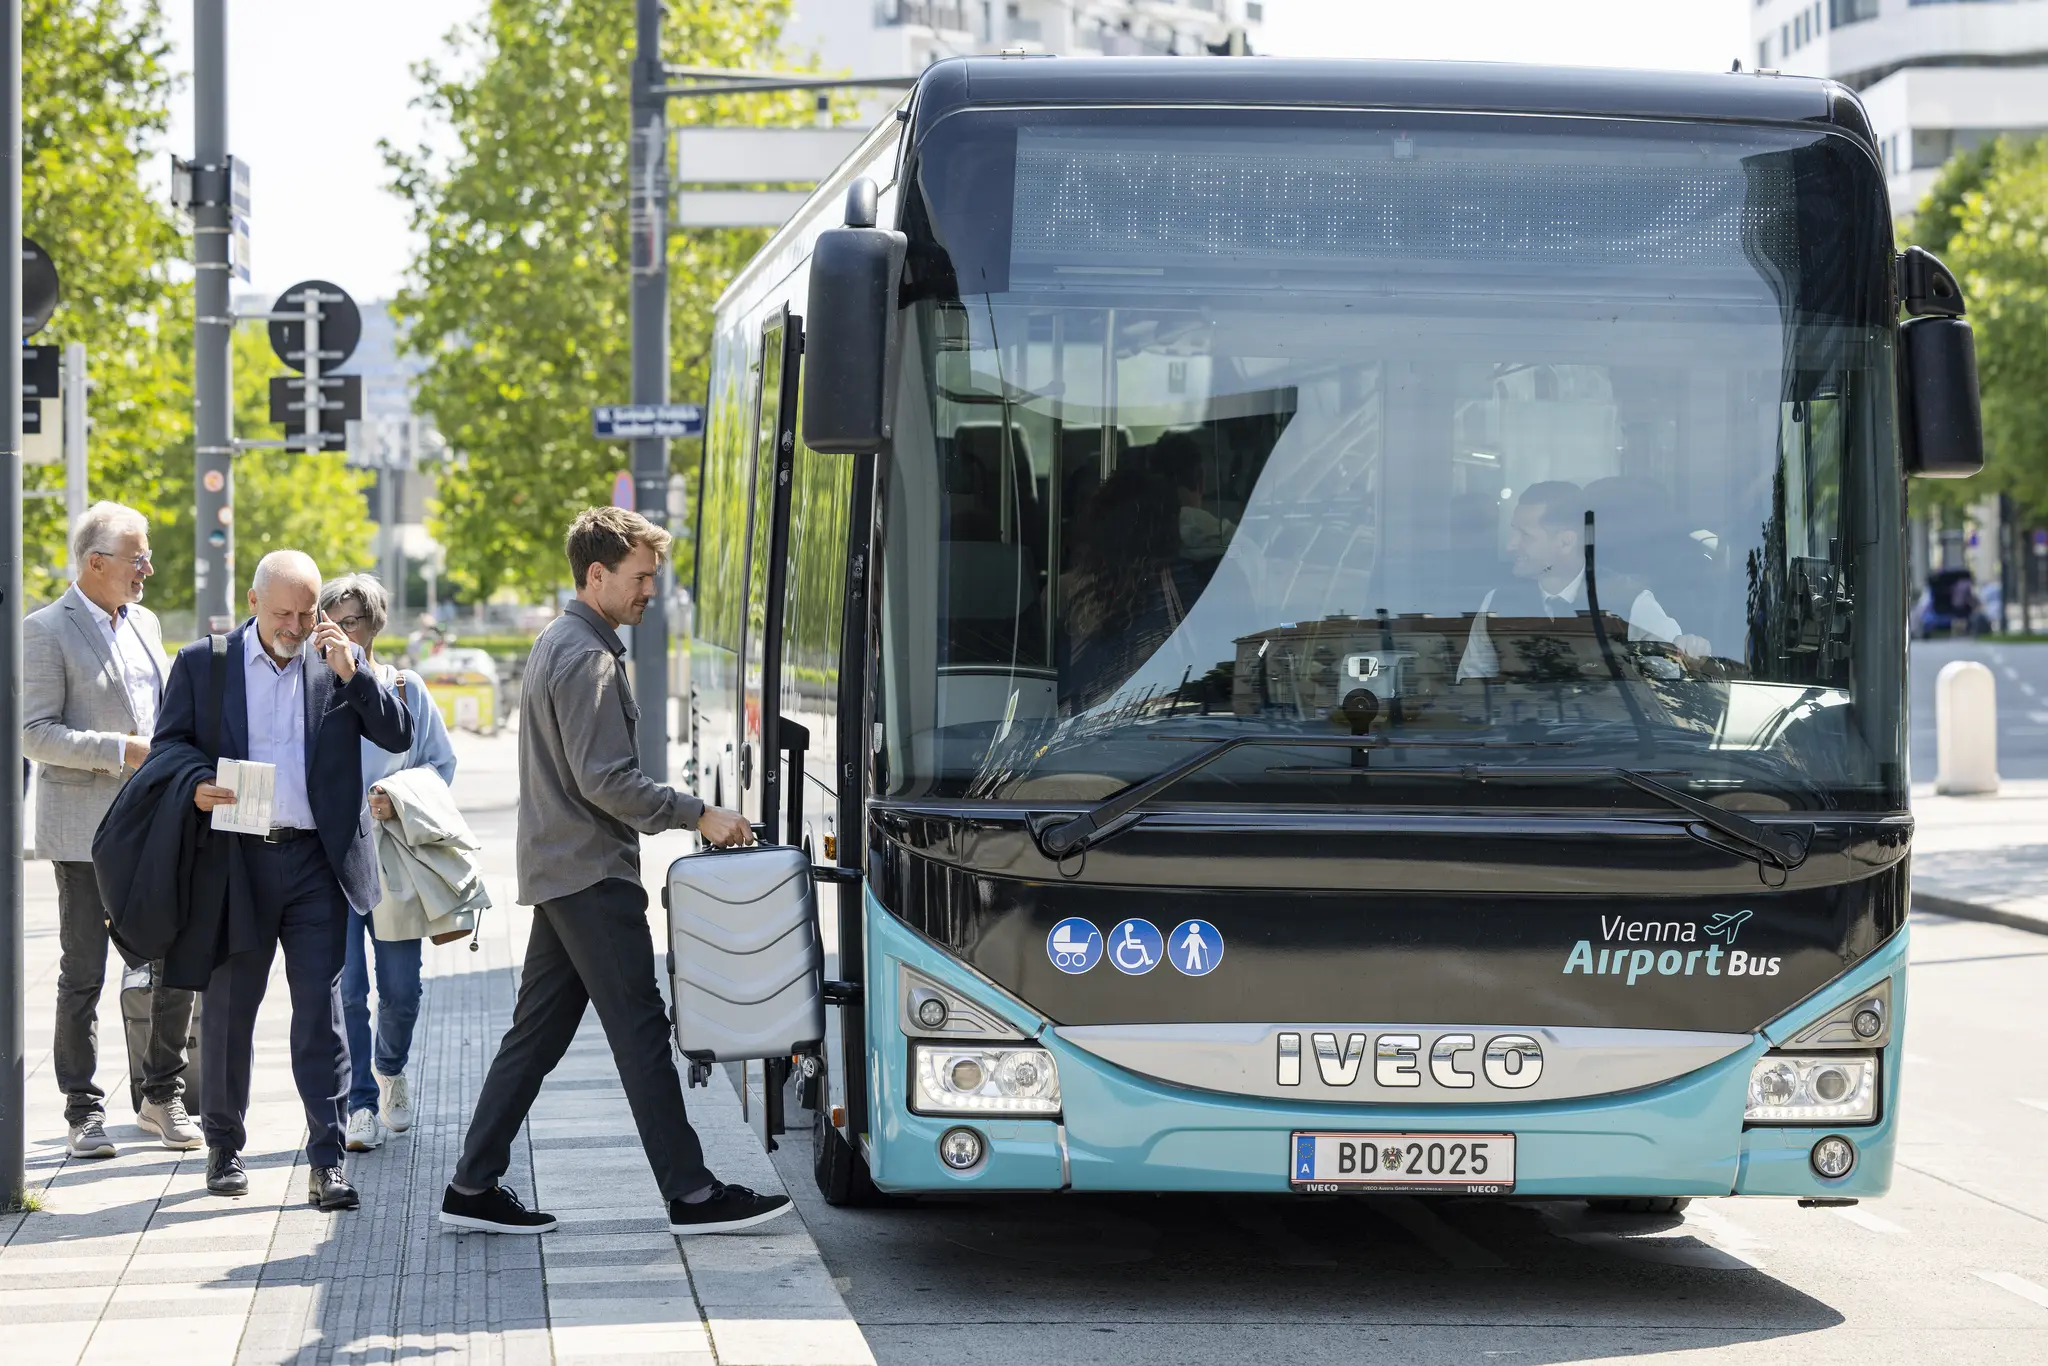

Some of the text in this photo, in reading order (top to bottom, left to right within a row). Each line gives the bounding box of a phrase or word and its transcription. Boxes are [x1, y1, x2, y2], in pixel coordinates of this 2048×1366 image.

[1601, 915, 1697, 942] Vienna
[1276, 1032, 1544, 1090] IVECO
[1338, 1142, 1489, 1175] BD 2025
[1300, 1163, 1310, 1173] A
[1306, 1184, 1338, 1192] IVECO
[1467, 1185, 1499, 1193] IVECO
